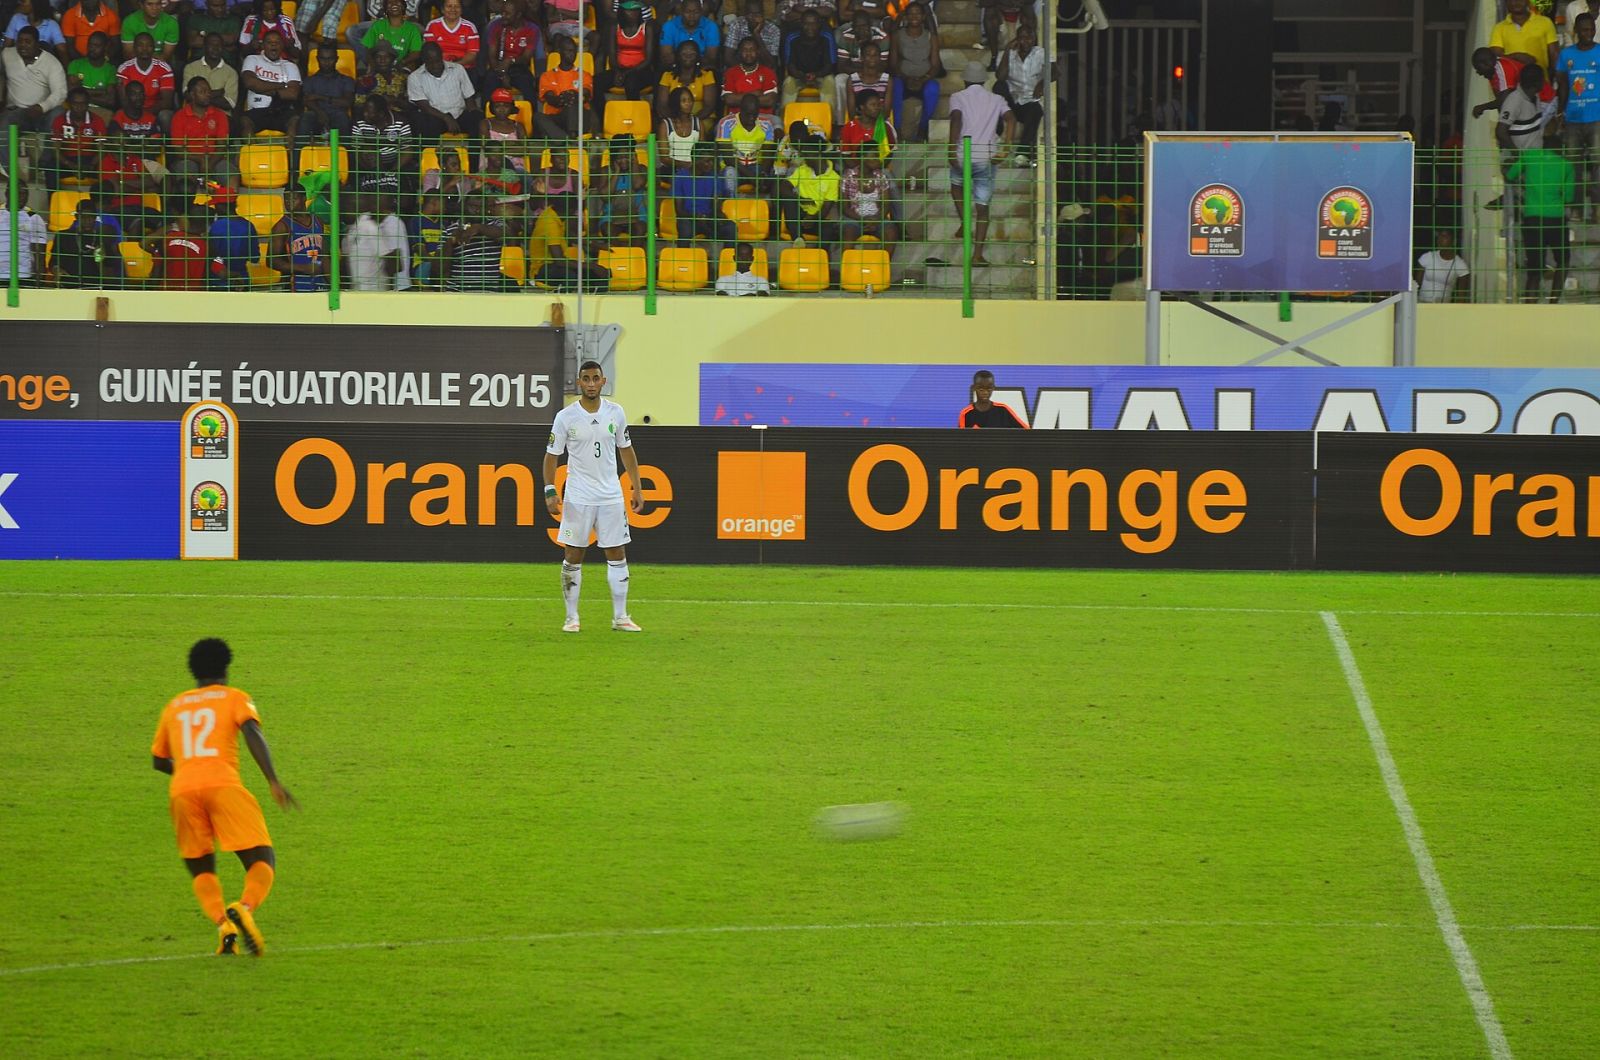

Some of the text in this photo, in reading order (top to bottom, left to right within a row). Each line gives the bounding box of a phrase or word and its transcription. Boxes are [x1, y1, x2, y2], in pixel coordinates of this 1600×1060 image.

[62, 125, 75, 139] R
[1200, 226, 1233, 234] CAF
[99, 362, 223, 403] GUINÉE
[232, 362, 461, 407] ÉQUATORIALE
[469, 373, 551, 408] 2015
[593, 441, 602, 459] 3
[848, 443, 1247, 554] Orange
[1380, 448, 1600, 539] Ora
[177, 707, 219, 759] 12
